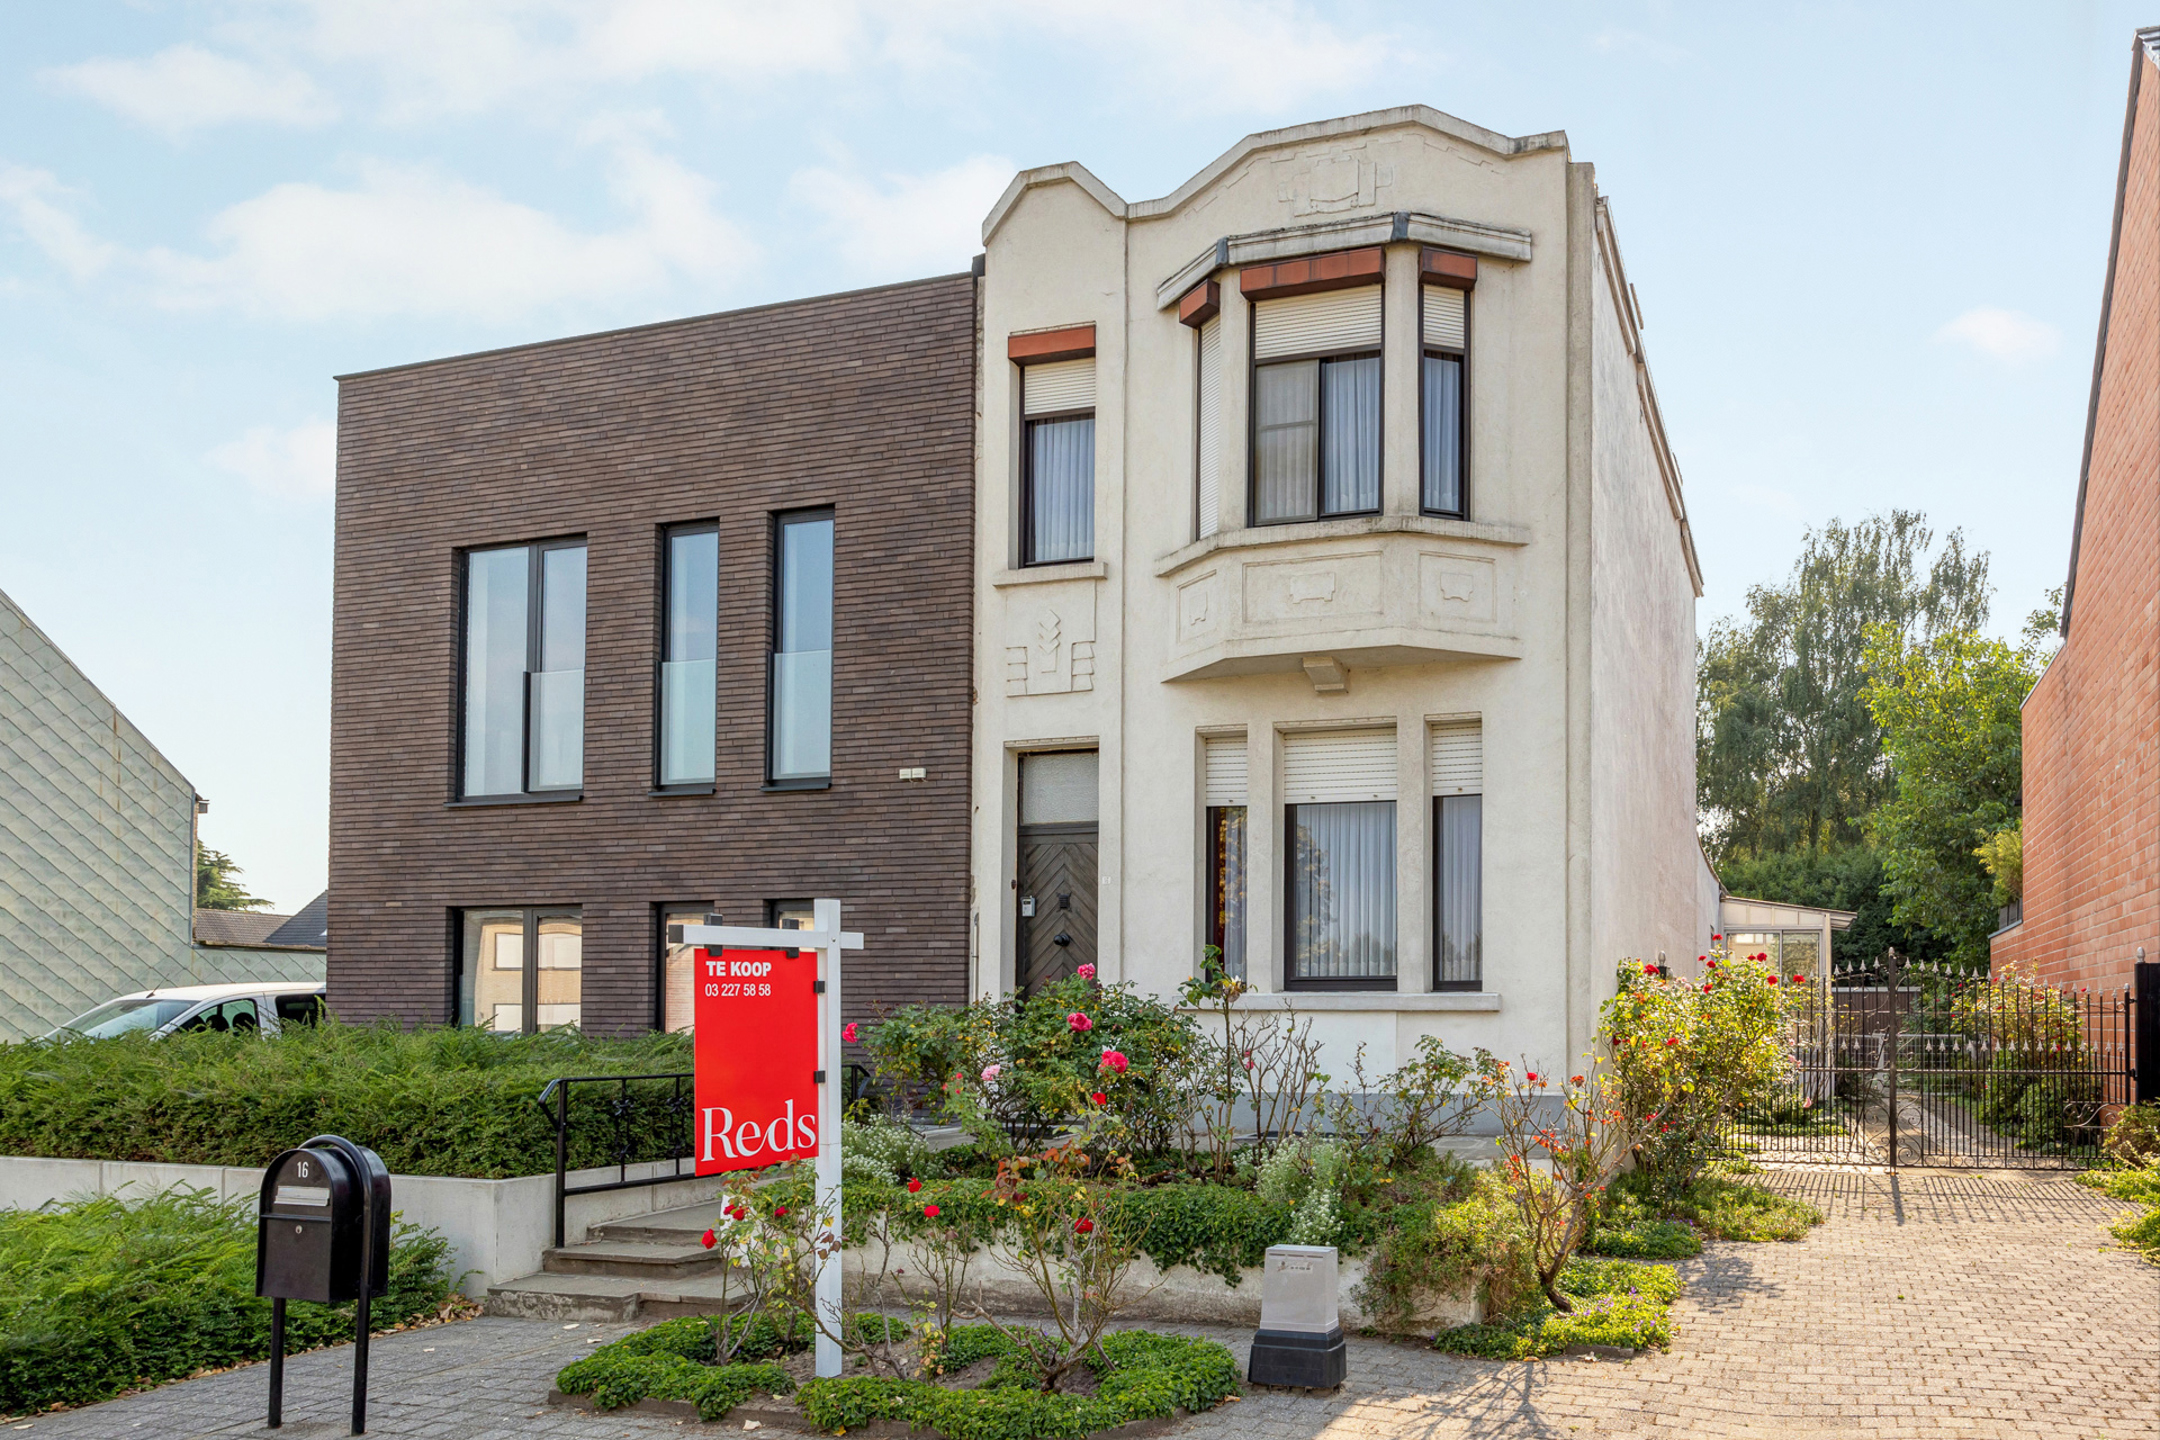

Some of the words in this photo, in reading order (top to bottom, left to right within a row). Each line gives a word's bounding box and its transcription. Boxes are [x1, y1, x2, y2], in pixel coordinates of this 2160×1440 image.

[705, 961, 726, 977] TE
[730, 961, 772, 977] KOOP
[705, 983, 719, 997] 03
[721, 983, 741, 997] 227
[743, 983, 757, 997] 58
[758, 983, 772, 997] 58
[701, 1099, 816, 1162] Reds
[297, 1161, 309, 1178] 16
